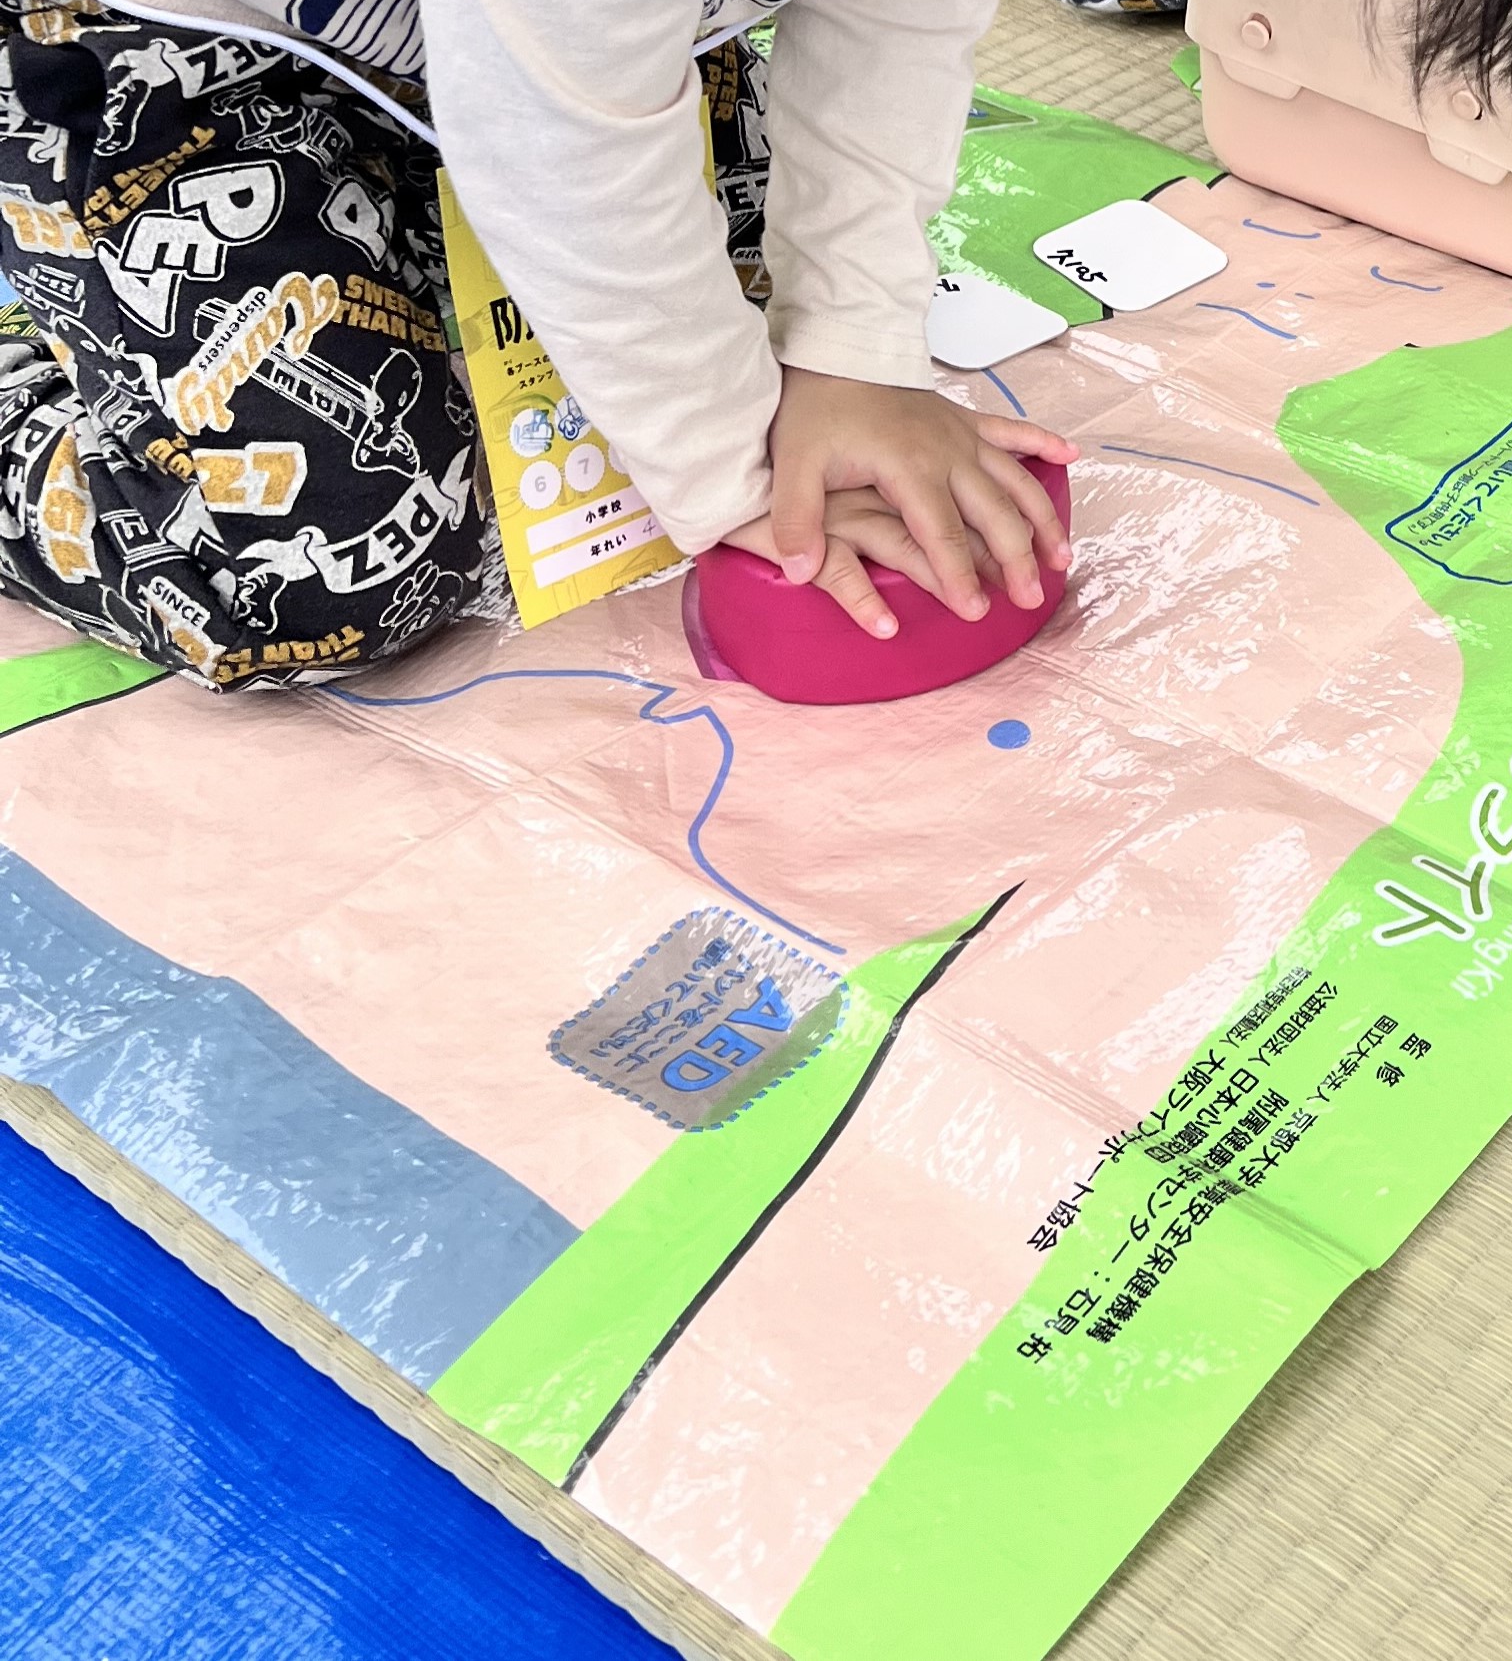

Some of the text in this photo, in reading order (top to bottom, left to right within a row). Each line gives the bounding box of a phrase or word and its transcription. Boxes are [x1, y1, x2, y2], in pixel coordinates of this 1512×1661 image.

[93, 164, 282, 338] PEZ
[177, 275, 338, 432] Candy
[199, 291, 267, 372] dispensers
[534, 475, 547, 493] 6
[578, 458, 591, 476] 7
[332, 495, 440, 585] PEZ
[585, 499, 623, 524] 小学校
[589, 533, 628, 557] 年れい
[152, 580, 206, 629] SINCE
[660, 976, 791, 1092] AED
[1249, 979, 1340, 1069] 公益財団法人
[1308, 1014, 1397, 1106] 国立大学法人
